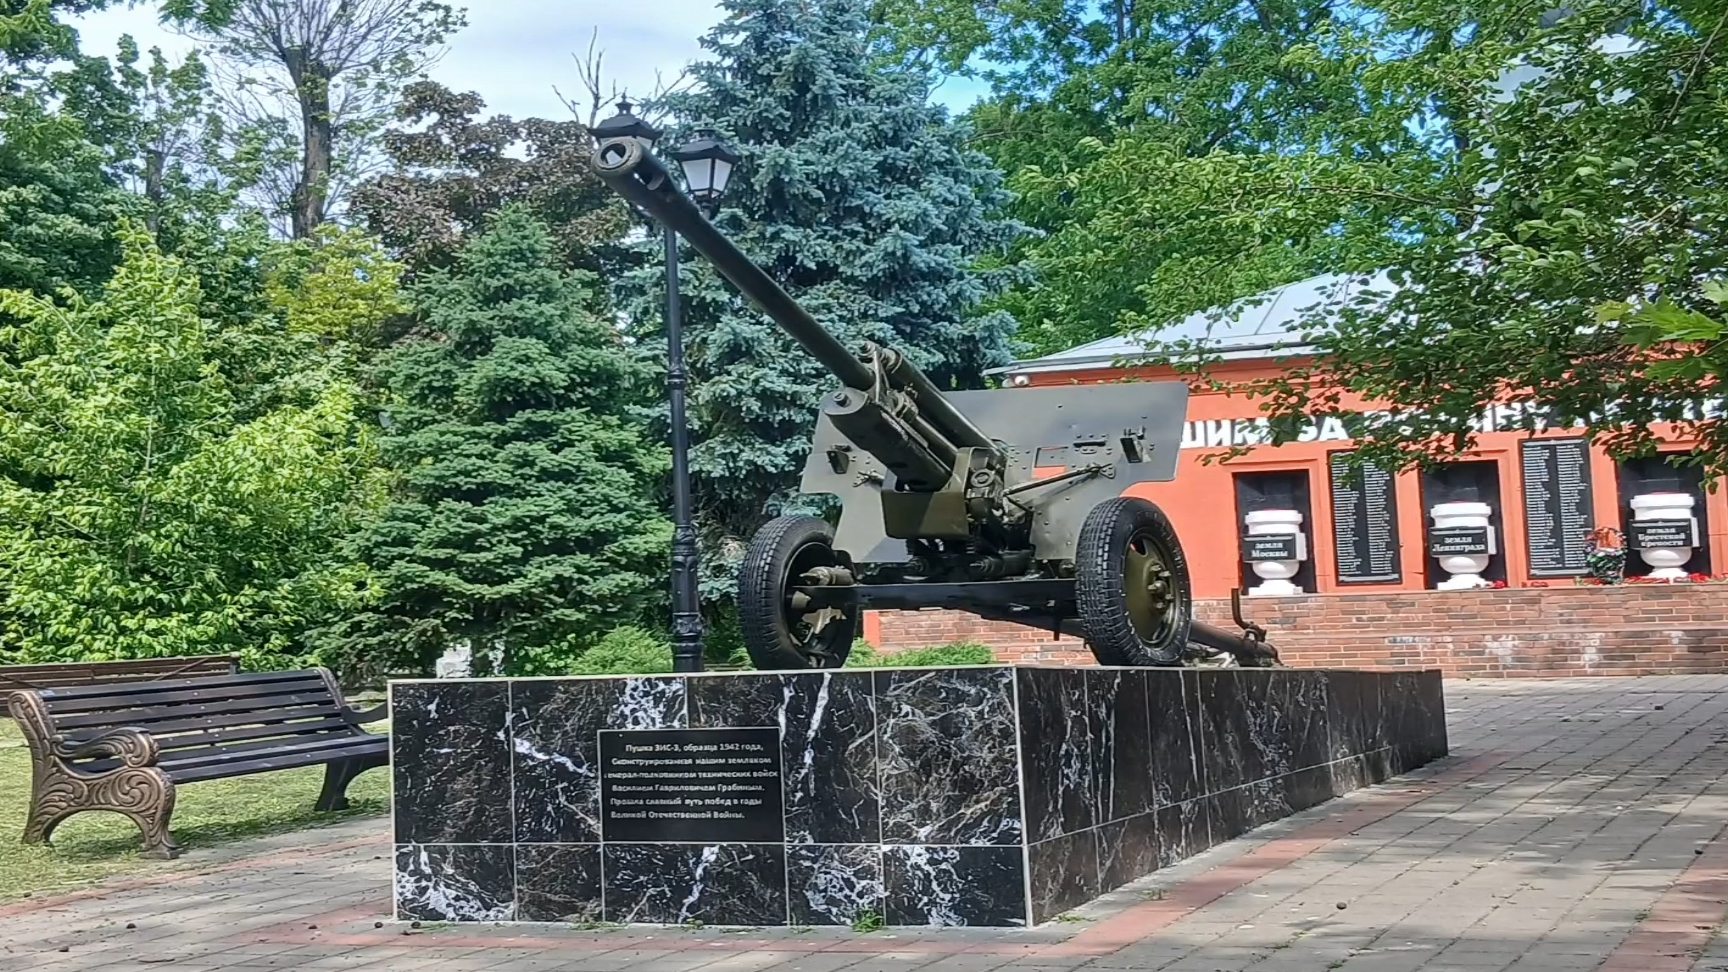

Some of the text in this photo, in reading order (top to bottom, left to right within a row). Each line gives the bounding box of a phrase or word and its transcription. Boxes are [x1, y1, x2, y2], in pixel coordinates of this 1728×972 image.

[626, 745, 653, 753] Пушка
[655, 744, 681, 752] ЗИС-3,
[683, 743, 718, 752] образца
[753, 769, 778, 777] войск
[655, 784, 717, 792] Гавриловичем
[717, 783, 765, 792] Грабиным.
[610, 798, 644, 806] Прошла
[646, 796, 682, 804] славный
[704, 797, 733, 806] побед
